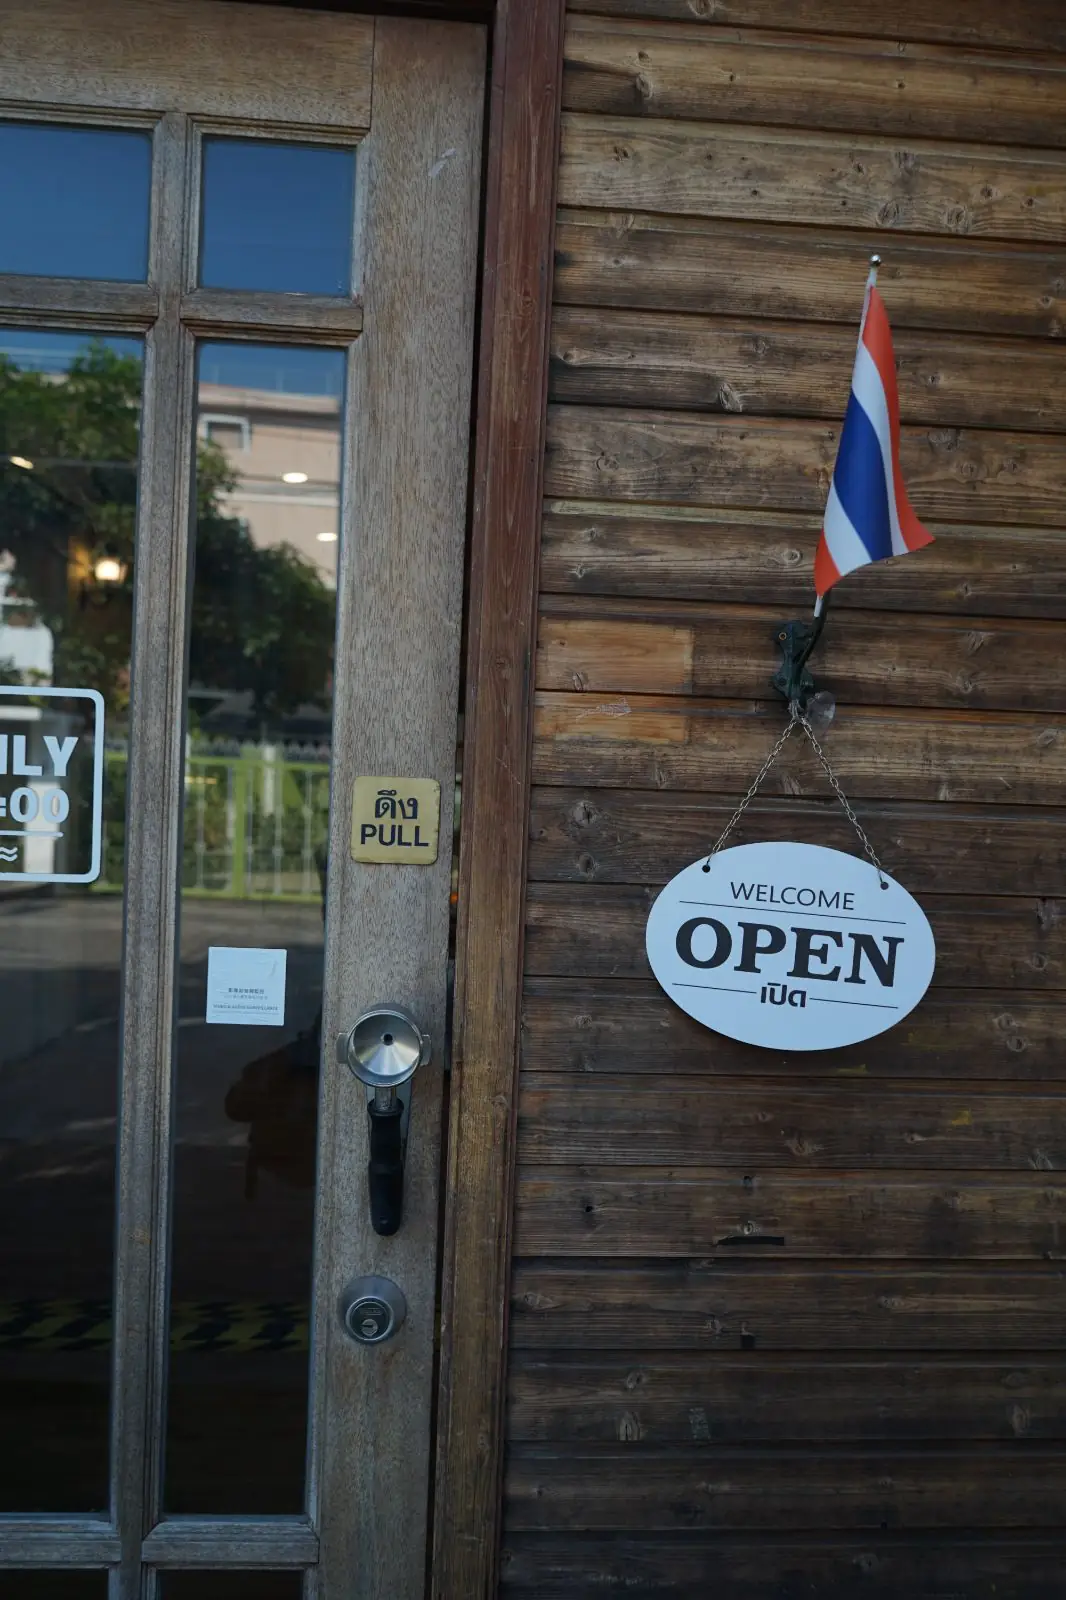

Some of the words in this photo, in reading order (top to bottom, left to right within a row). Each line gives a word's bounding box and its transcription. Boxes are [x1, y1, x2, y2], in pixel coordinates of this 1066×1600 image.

[374, 789, 418, 820] ดึง
[360, 823, 430, 847] PULL
[730, 881, 855, 911] WELCOME
[675, 916, 905, 988] OPEN
[760, 982, 807, 1008] เปิด
